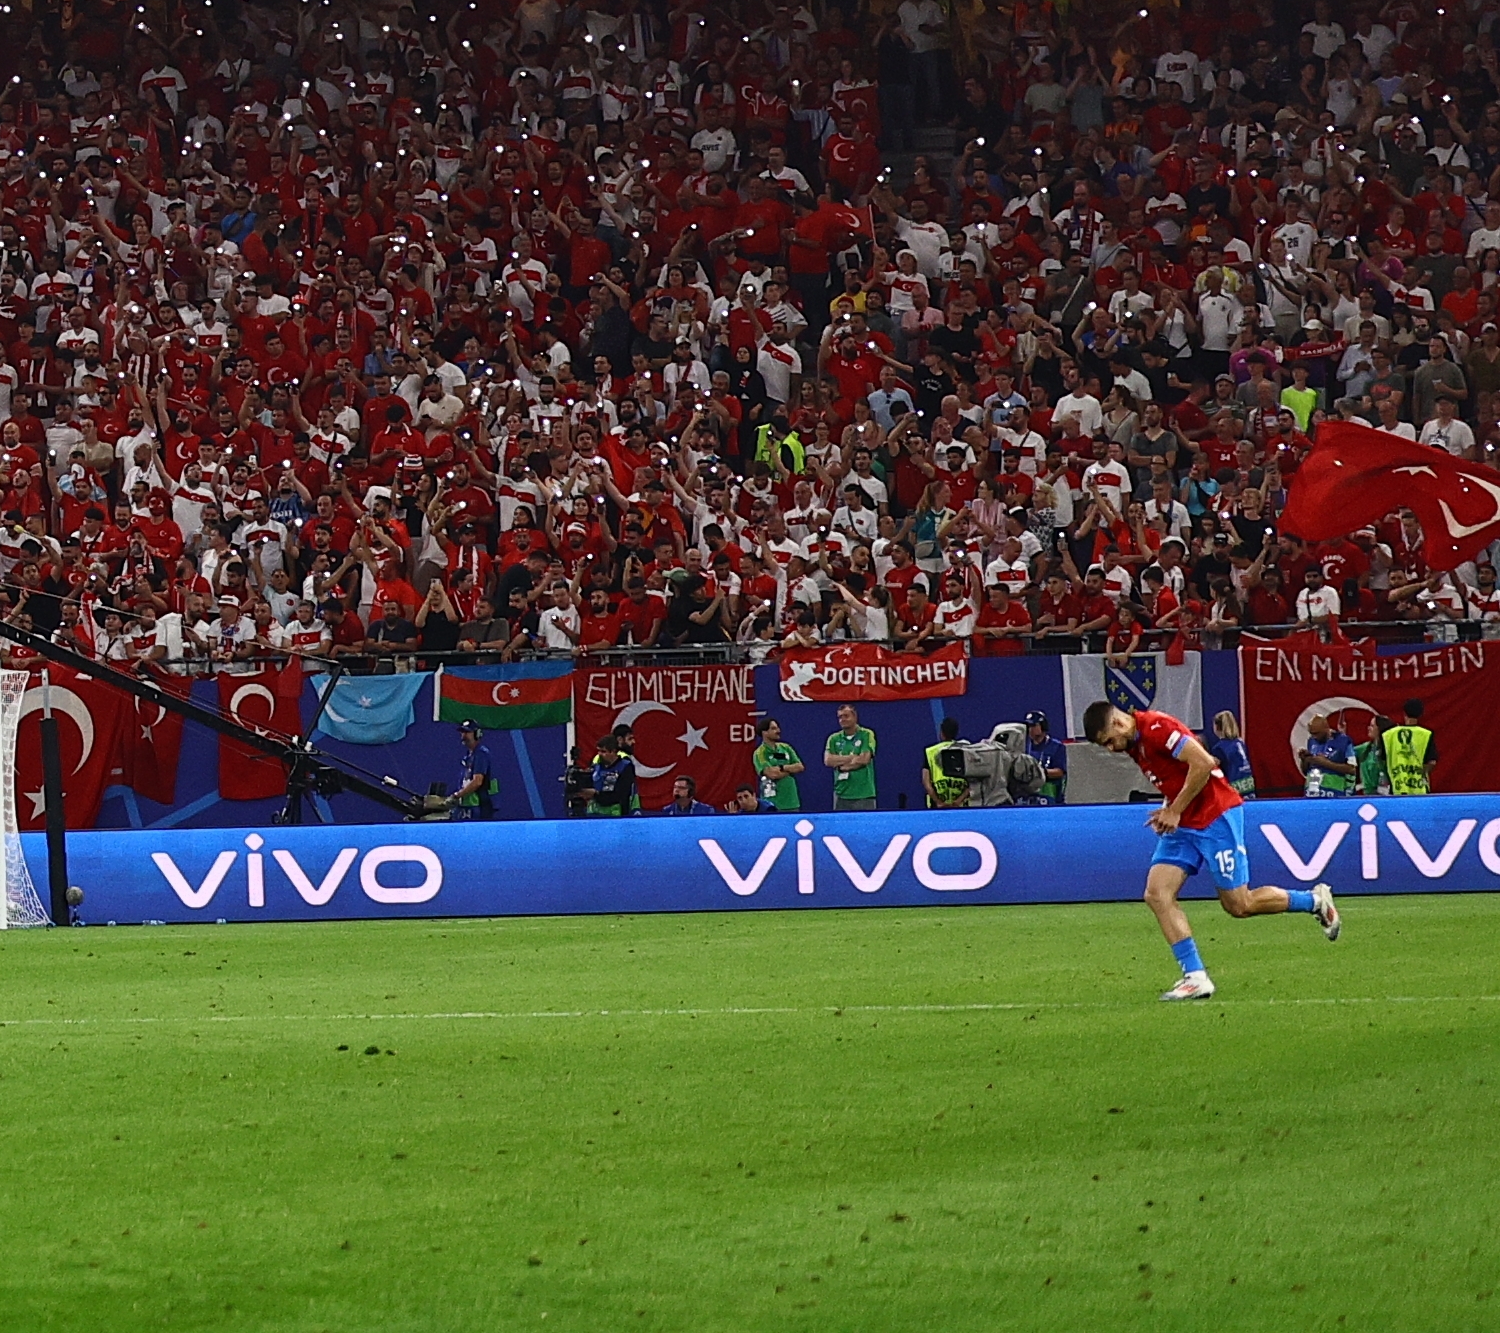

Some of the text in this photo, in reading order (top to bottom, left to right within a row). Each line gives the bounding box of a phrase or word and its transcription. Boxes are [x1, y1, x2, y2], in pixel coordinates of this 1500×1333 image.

[823, 658, 967, 687] DOETINCHEM
[151, 833, 443, 908] vivo
[698, 819, 997, 895] vivo
[1215, 849, 1236, 874] 15
